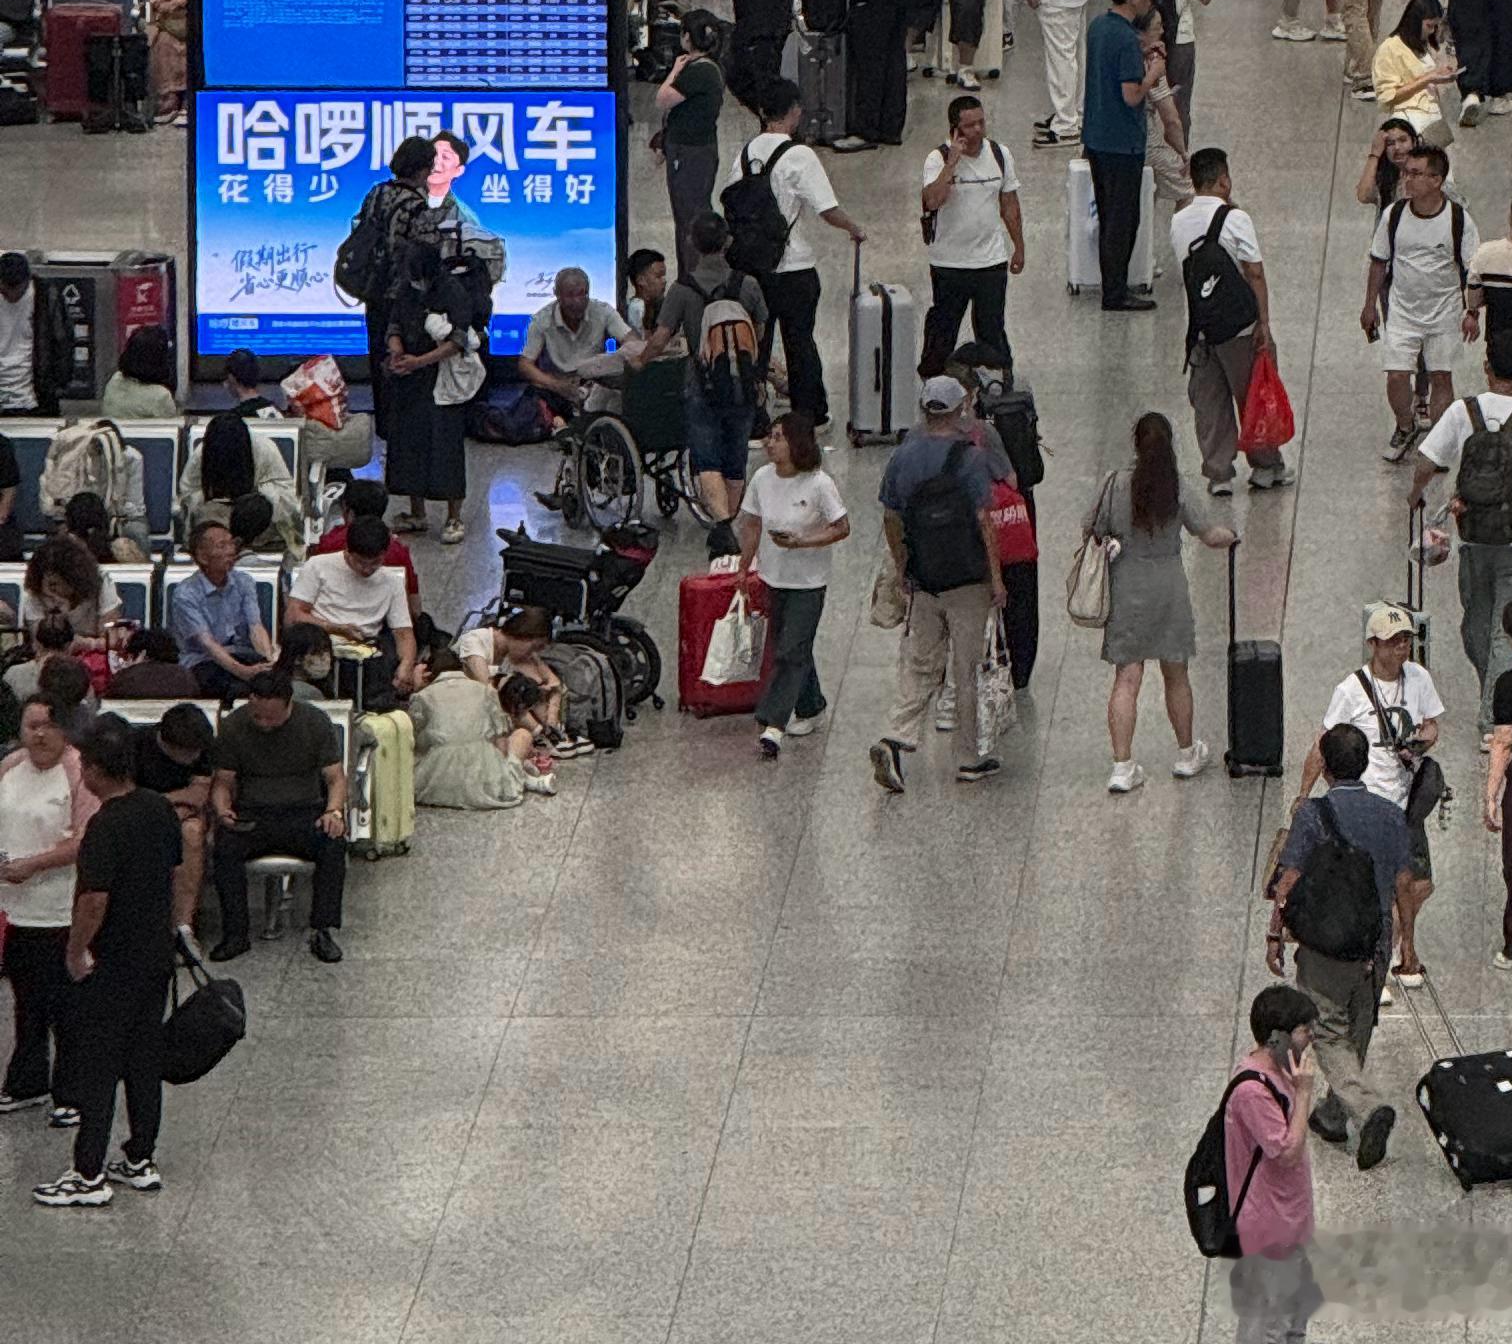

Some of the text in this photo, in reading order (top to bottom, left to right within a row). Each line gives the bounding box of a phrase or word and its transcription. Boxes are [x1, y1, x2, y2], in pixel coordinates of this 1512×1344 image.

[217, 99, 597, 171] 哈啰顺风车
[218, 173, 340, 204] 花得少
[481, 173, 597, 205] 坐得好
